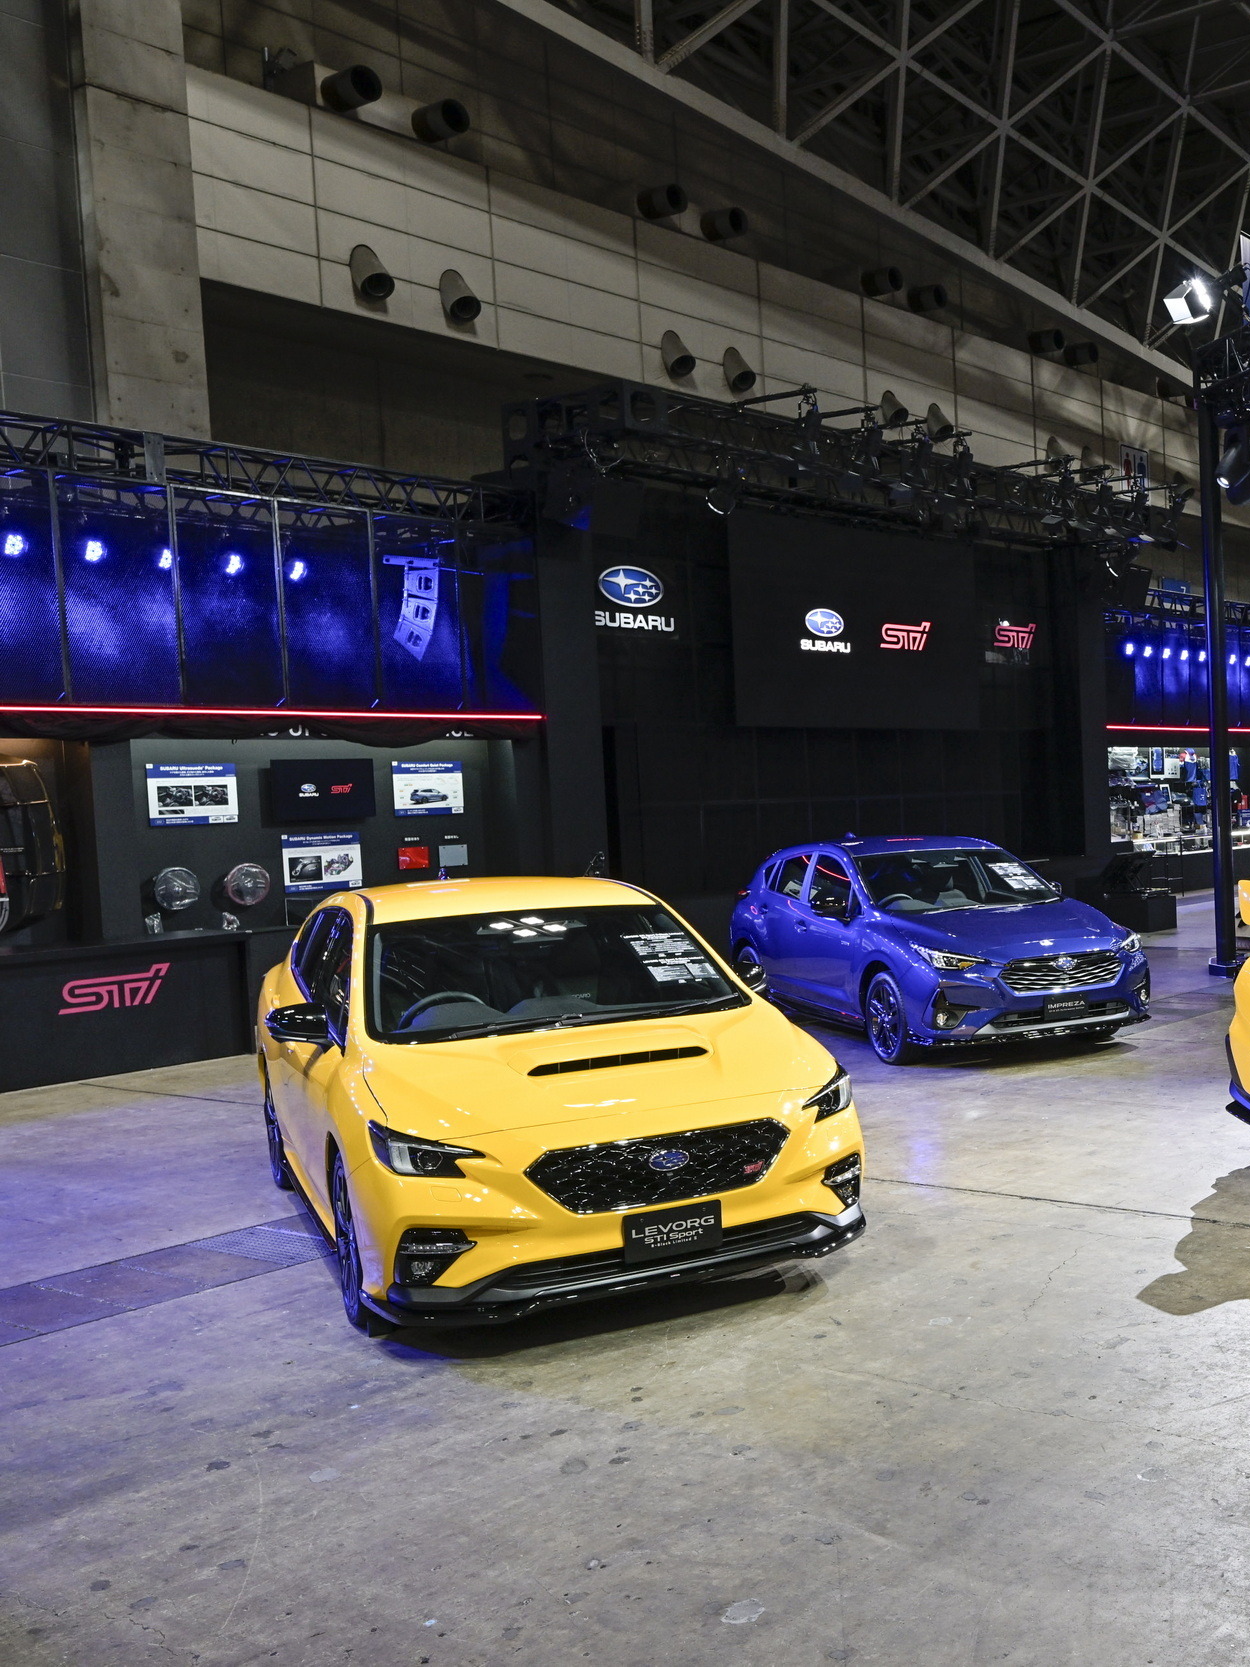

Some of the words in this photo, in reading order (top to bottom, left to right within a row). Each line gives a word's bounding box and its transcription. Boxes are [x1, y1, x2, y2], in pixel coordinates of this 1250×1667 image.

[595, 610, 674, 632] SUBARU
[800, 639, 851, 653] SUBARU
[1047, 1000, 1085, 1009] IMPREZA
[631, 1215, 715, 1239] LEVORG
[644, 1234, 667, 1244] STI
[669, 1227, 704, 1240] Sport
